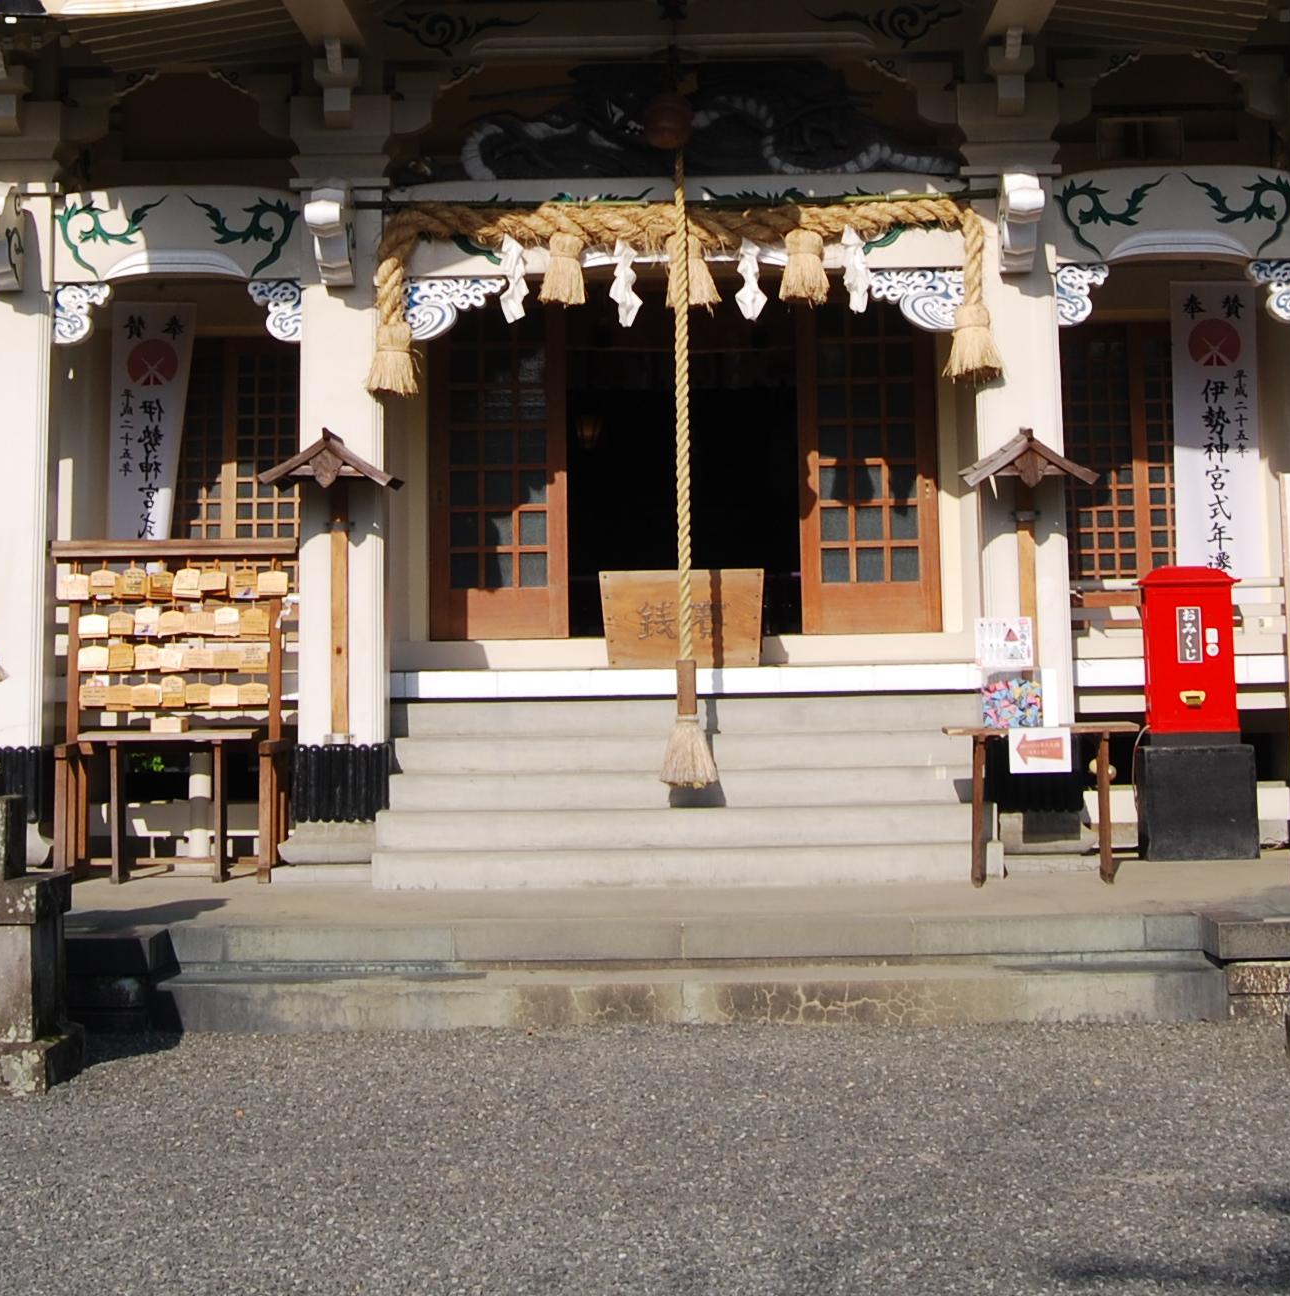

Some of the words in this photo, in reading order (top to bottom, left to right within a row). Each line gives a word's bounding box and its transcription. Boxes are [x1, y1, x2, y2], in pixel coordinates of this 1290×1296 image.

[1182, 293, 1246, 320] 奉賛
[1233, 369, 1250, 459] 平成二十五年
[1182, 608, 1198, 661] おみくじ
